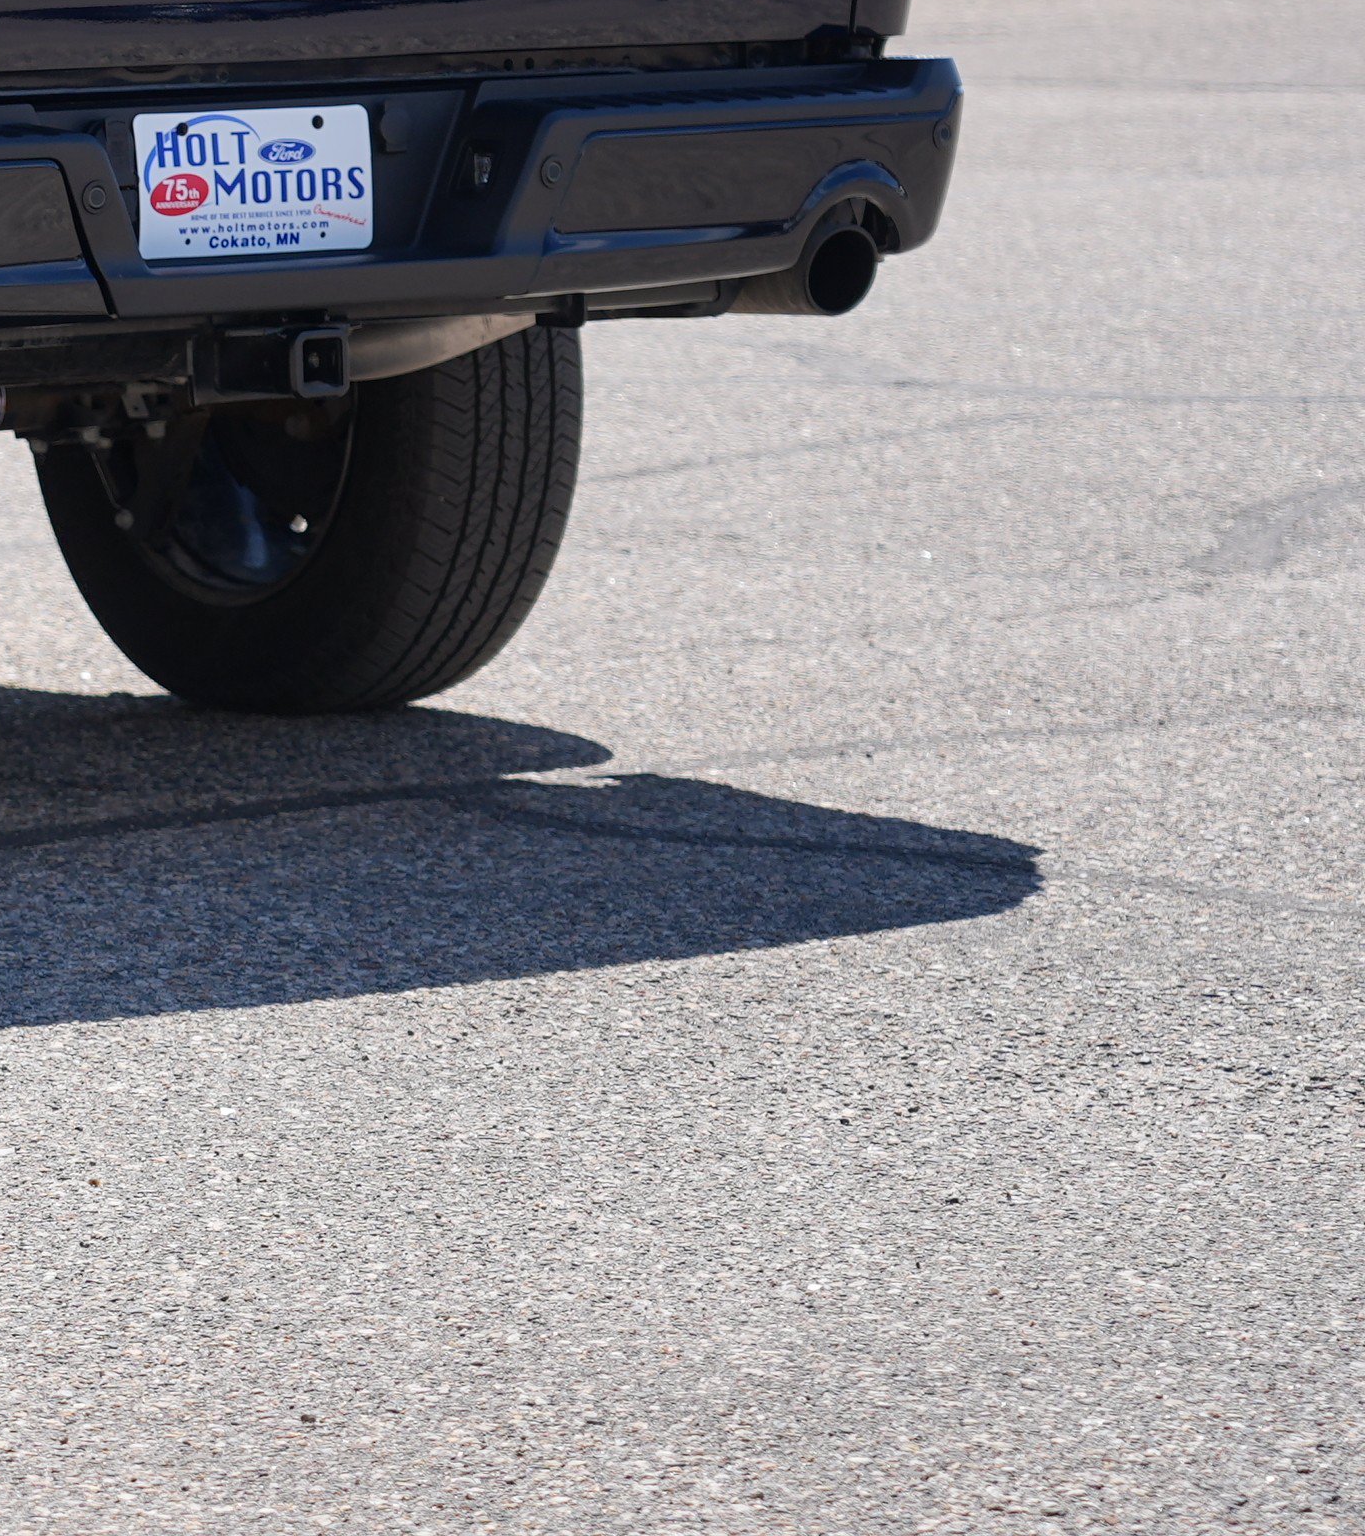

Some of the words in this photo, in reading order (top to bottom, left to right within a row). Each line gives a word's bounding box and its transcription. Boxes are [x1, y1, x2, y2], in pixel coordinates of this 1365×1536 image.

[156, 130, 250, 168] HOLT
[269, 142, 305, 161] Ford
[162, 178, 200, 202] 75th
[213, 166, 366, 206] MOTORS
[179, 220, 329, 235] www.holtmotors.com
[209, 235, 270, 249] Cokato,
[276, 232, 300, 245] MN
